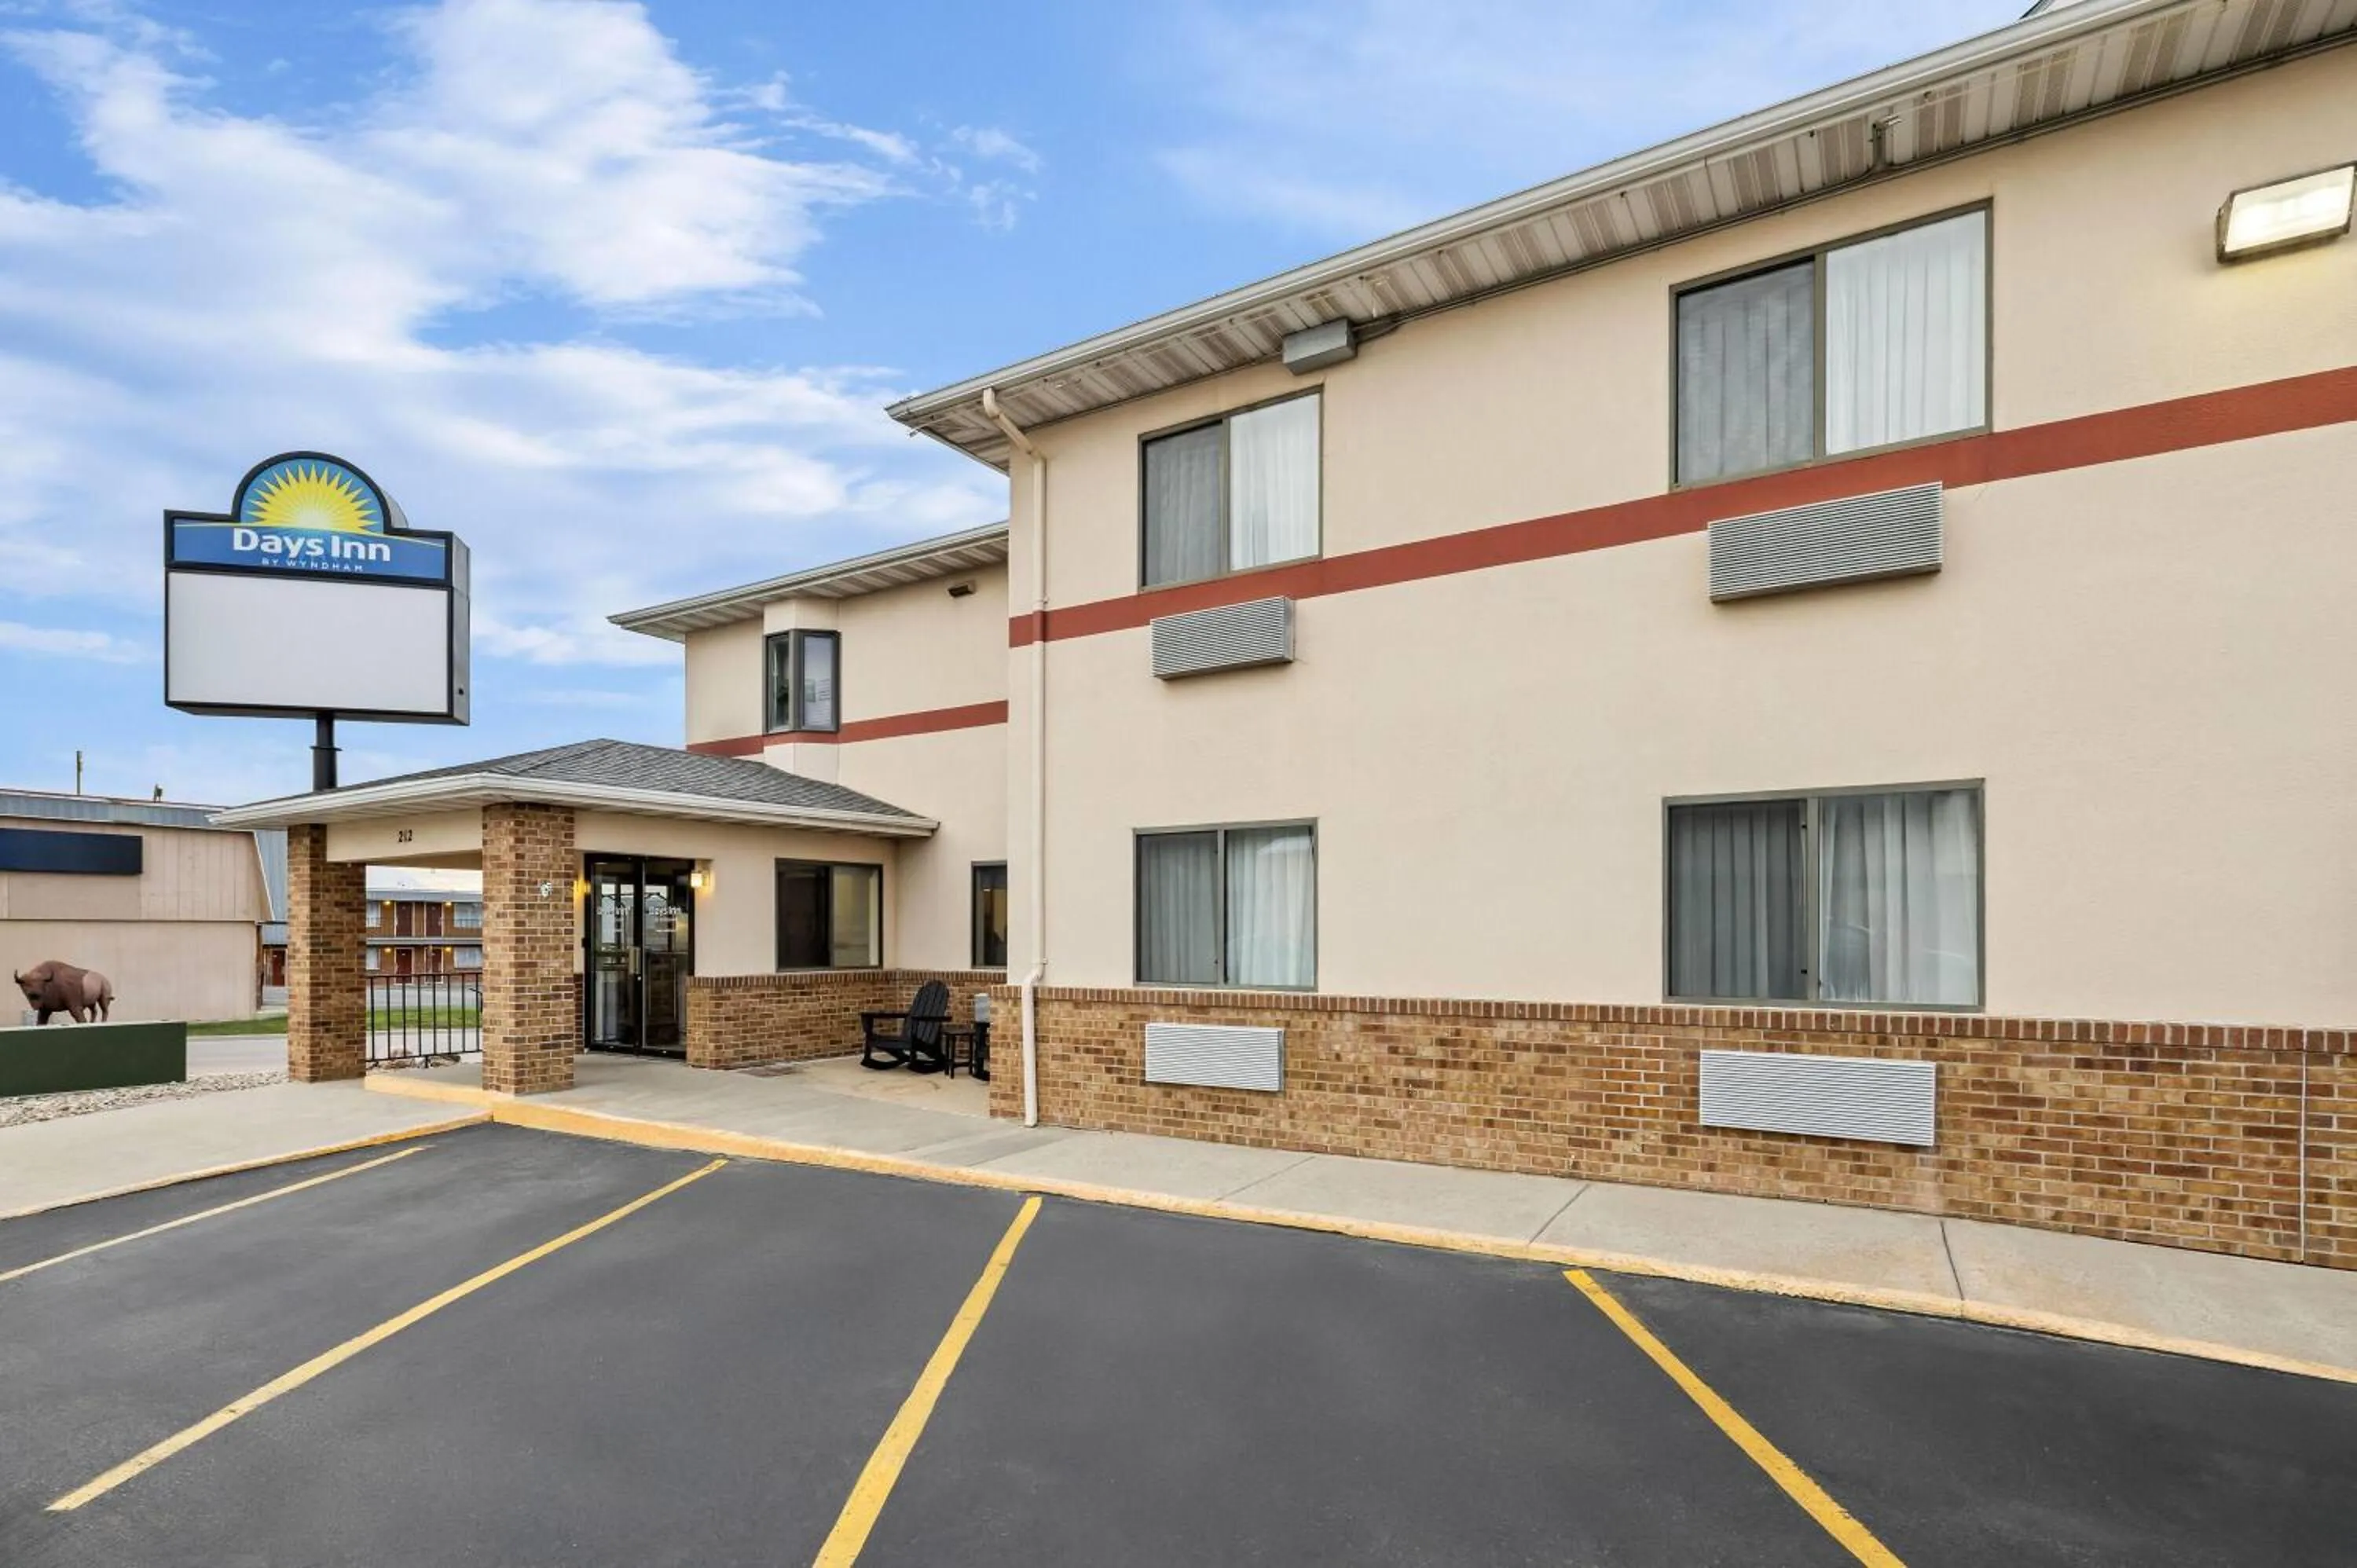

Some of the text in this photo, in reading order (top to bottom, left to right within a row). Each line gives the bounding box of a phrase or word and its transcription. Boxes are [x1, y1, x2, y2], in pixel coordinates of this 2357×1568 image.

[233, 527, 390, 562] Days Inn
[262, 557, 364, 572] BY WYNDHAM
